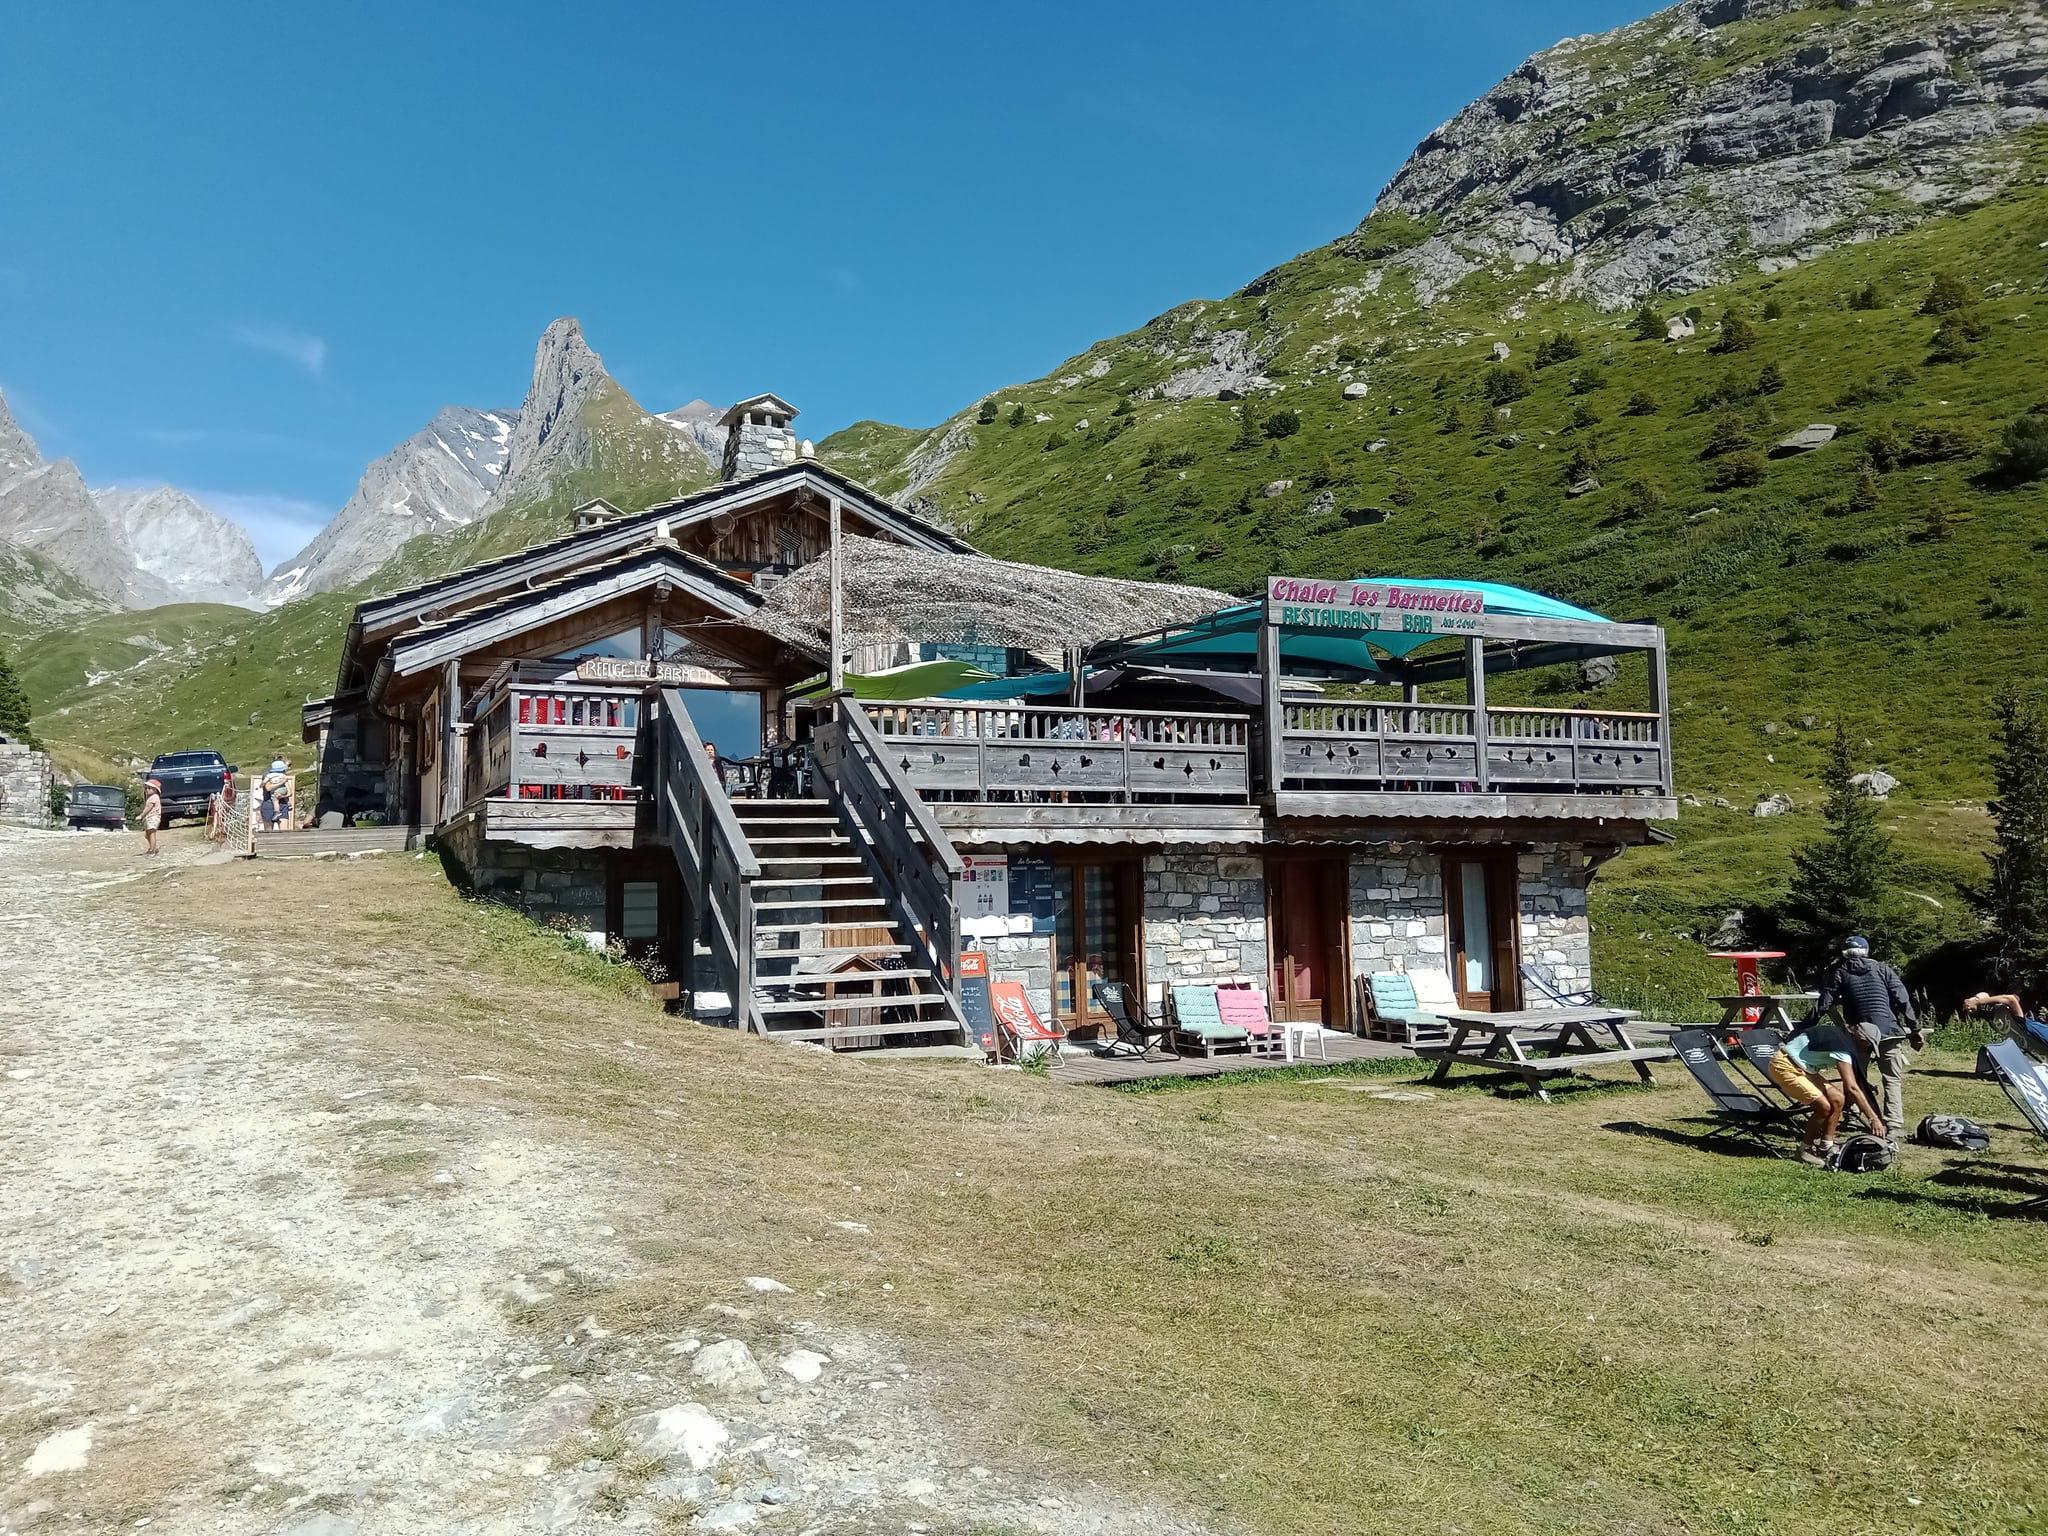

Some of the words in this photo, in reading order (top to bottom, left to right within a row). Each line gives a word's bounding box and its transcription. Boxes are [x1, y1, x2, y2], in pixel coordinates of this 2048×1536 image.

[1272, 579, 1337, 604] Chalet
[1349, 585, 1380, 607] les
[1386, 587, 1483, 613] Barmettes
[1282, 606, 1380, 630] RESTAURANT
[1403, 613, 1433, 632] BAR
[585, 660, 627, 678] REFUGE
